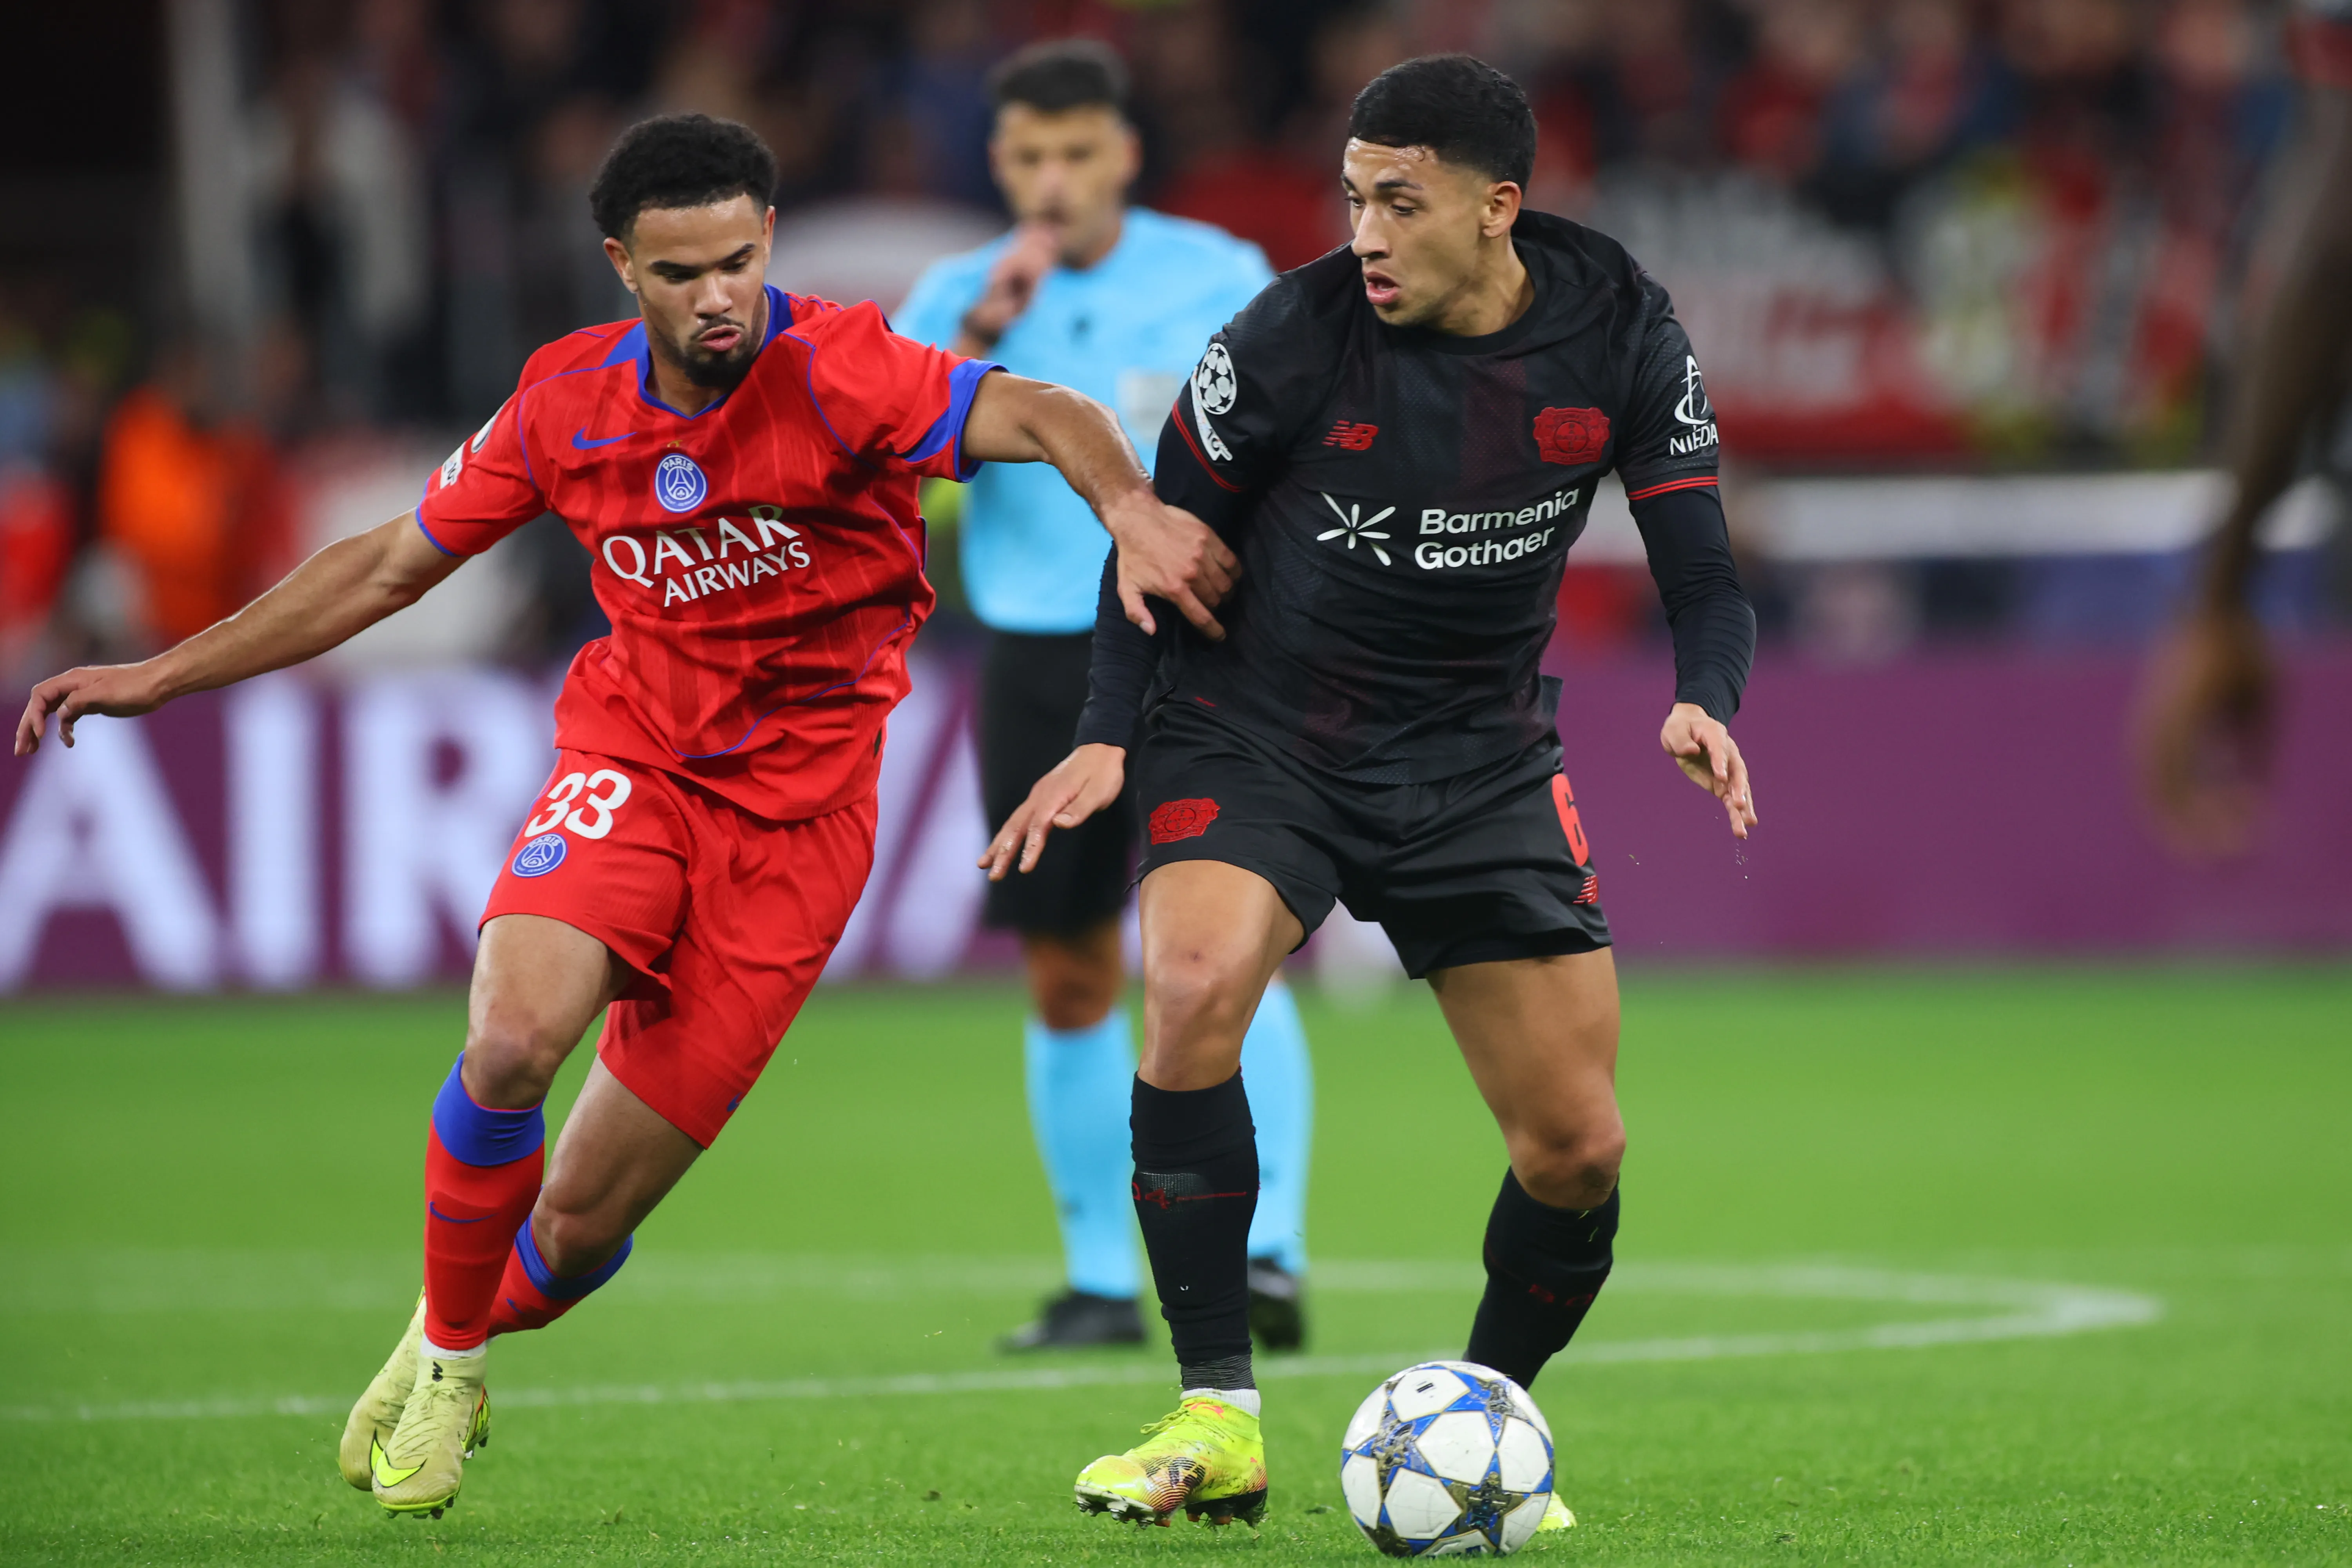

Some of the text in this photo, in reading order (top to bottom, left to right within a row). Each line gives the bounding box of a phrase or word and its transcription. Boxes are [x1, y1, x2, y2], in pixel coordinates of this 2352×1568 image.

[662, 457, 693, 471] PARIS
[1419, 488, 1579, 534] Barmenia
[602, 505, 800, 588] QATAR
[664, 541, 810, 607] AIRWAYS
[1414, 526, 1555, 570] Gothaer
[524, 769, 632, 840] 33
[1552, 773, 1589, 867] 6
